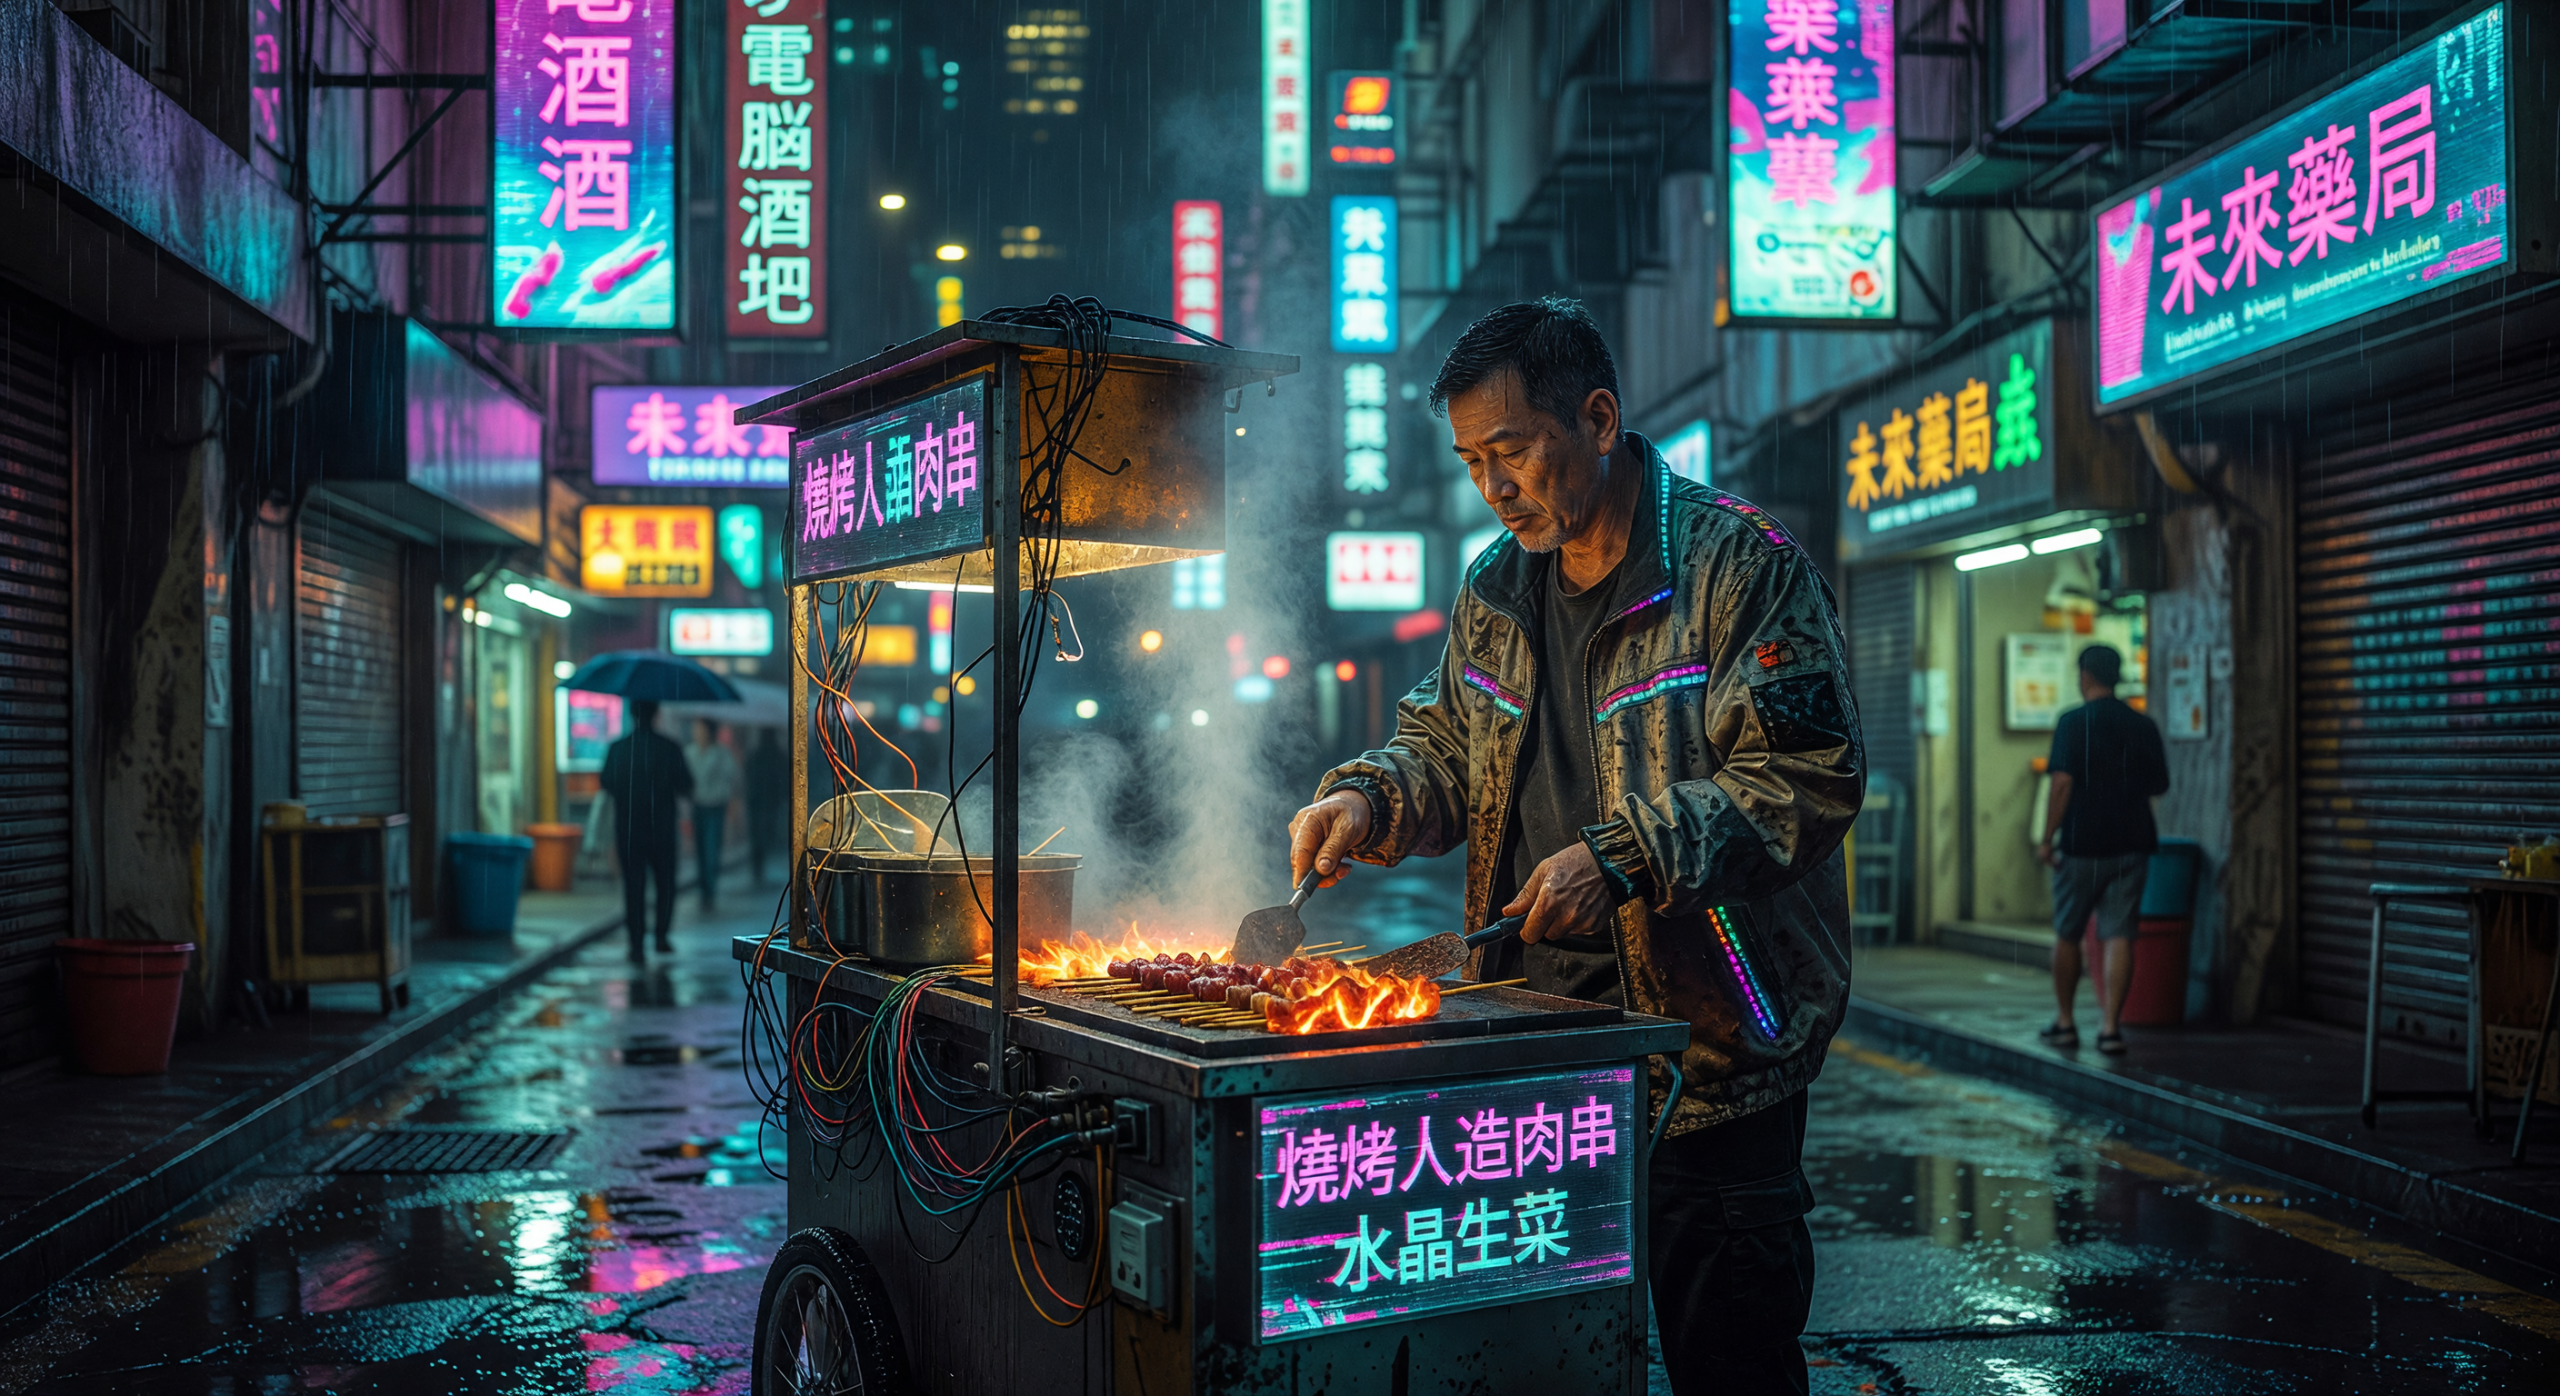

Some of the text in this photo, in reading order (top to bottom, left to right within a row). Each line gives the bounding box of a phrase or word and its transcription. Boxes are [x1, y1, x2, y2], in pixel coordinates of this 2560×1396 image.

[538, 0, 633, 231] 酒酒
[738, 0, 814, 325] 電脳酒吧
[2161, 83, 2436, 315] 未來藥局
[1276, 1095, 1617, 1210] 燒烤人造肉串
[1333, 1188, 1571, 1293] 水晶生菜
